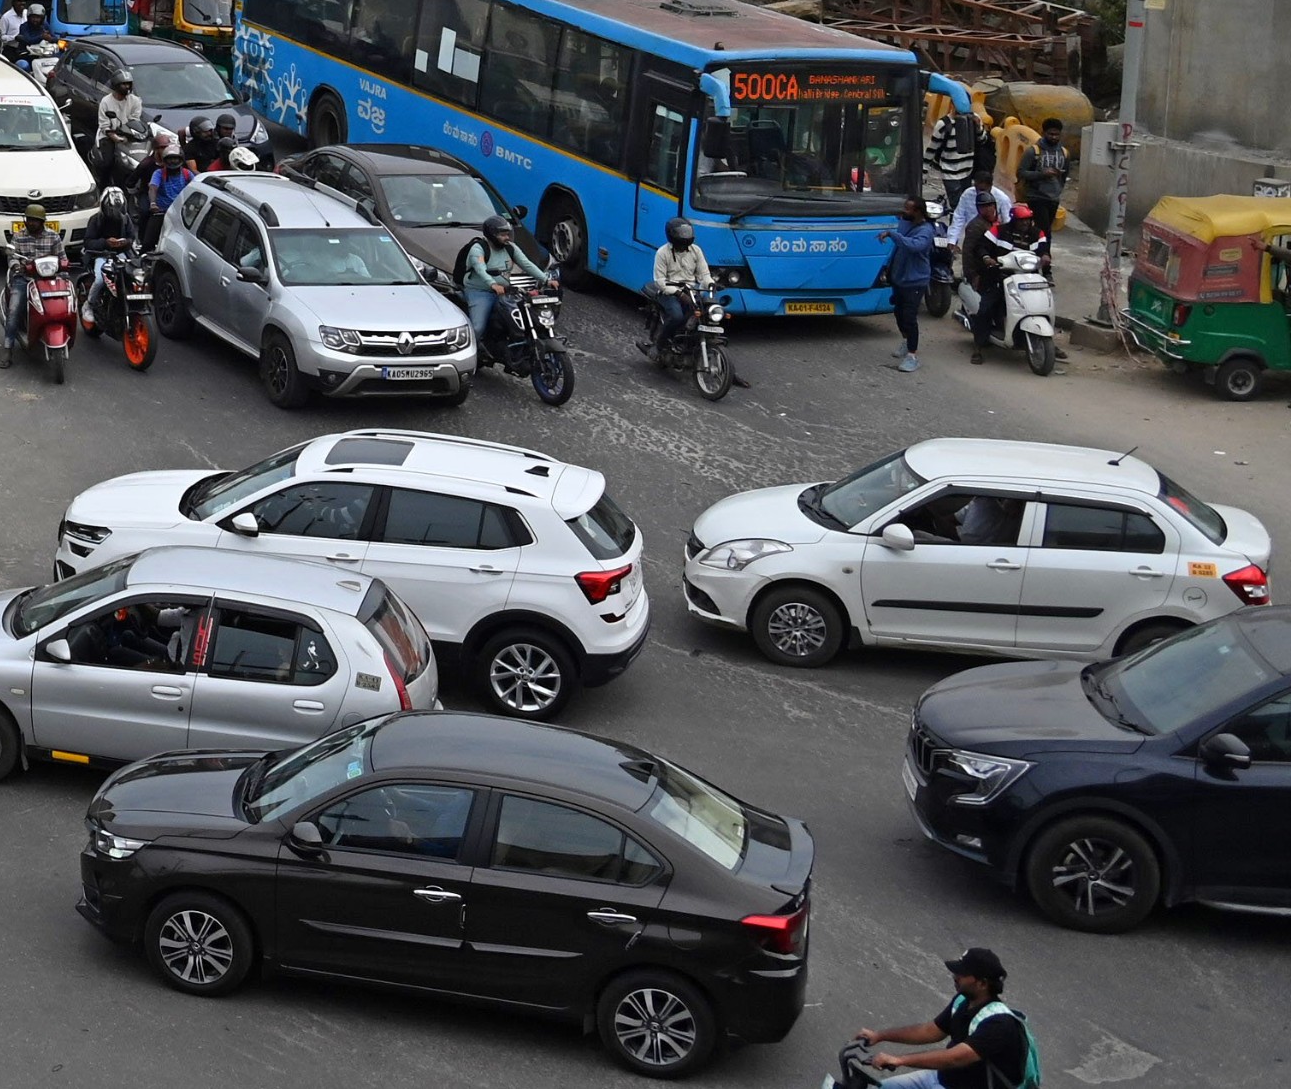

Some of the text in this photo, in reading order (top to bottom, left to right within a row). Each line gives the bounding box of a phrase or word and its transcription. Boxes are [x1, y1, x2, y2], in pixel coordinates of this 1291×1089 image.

[359, 78, 387, 100] VAJRA
[734, 73, 799, 101] 500CA
[357, 99, 386, 135] ವಜ್ರ
[495, 146, 533, 170] BMTC
